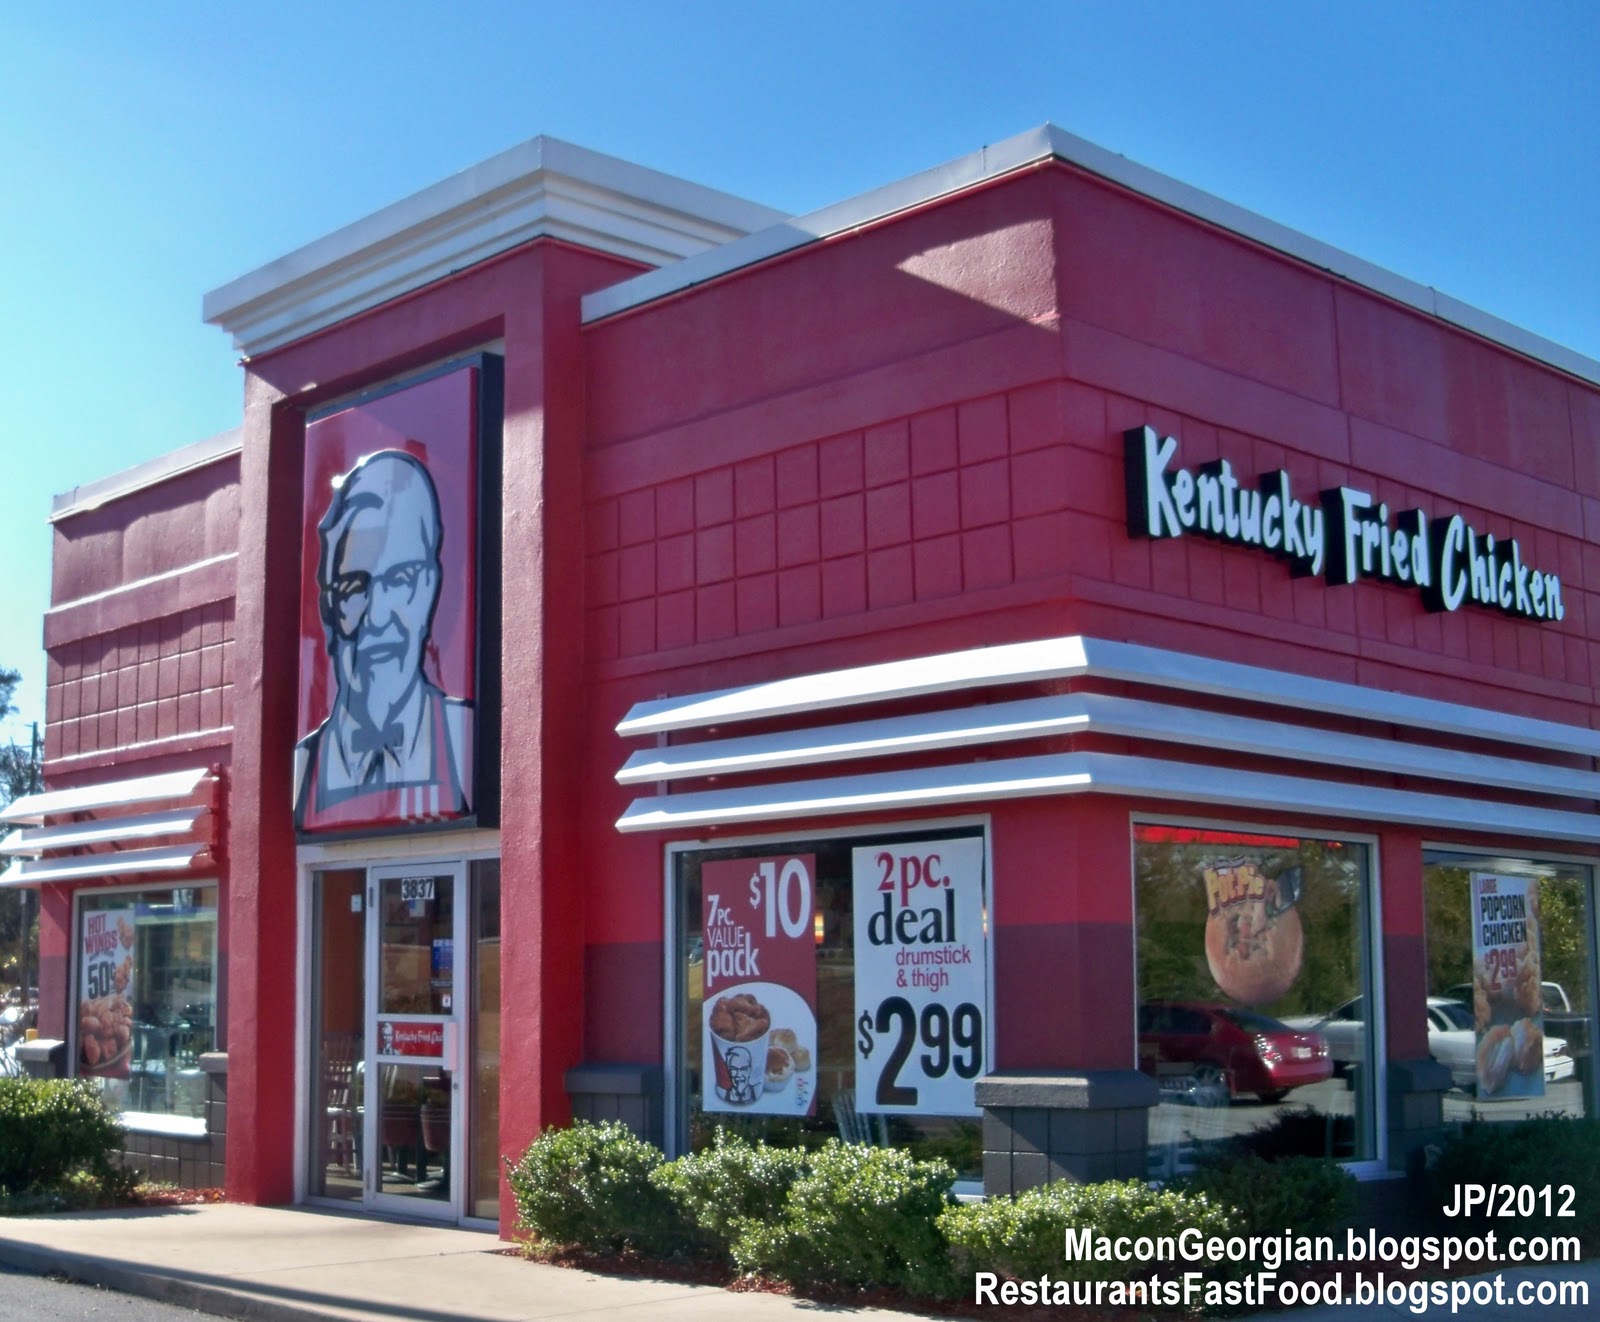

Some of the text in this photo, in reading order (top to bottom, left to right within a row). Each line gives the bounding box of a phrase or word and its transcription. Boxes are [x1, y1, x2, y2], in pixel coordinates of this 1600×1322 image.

[1145, 425, 1565, 621] Kentucky Fried Chicken
[402, 879, 434, 900] 3837
[877, 852, 951, 906] 2 pc.
[749, 858, 812, 938] $10
[1480, 894, 1526, 921] POPCORN
[88, 913, 107, 933] HOT
[867, 888, 956, 946] deal
[85, 930, 118, 954] WINGS
[707, 925, 745, 948] VALUE
[1482, 921, 1527, 946] CHICKEN
[707, 932, 760, 987] pack
[896, 945, 971, 966] drumstick
[896, 967, 949, 992] & thigh
[858, 996, 982, 1106] $299
